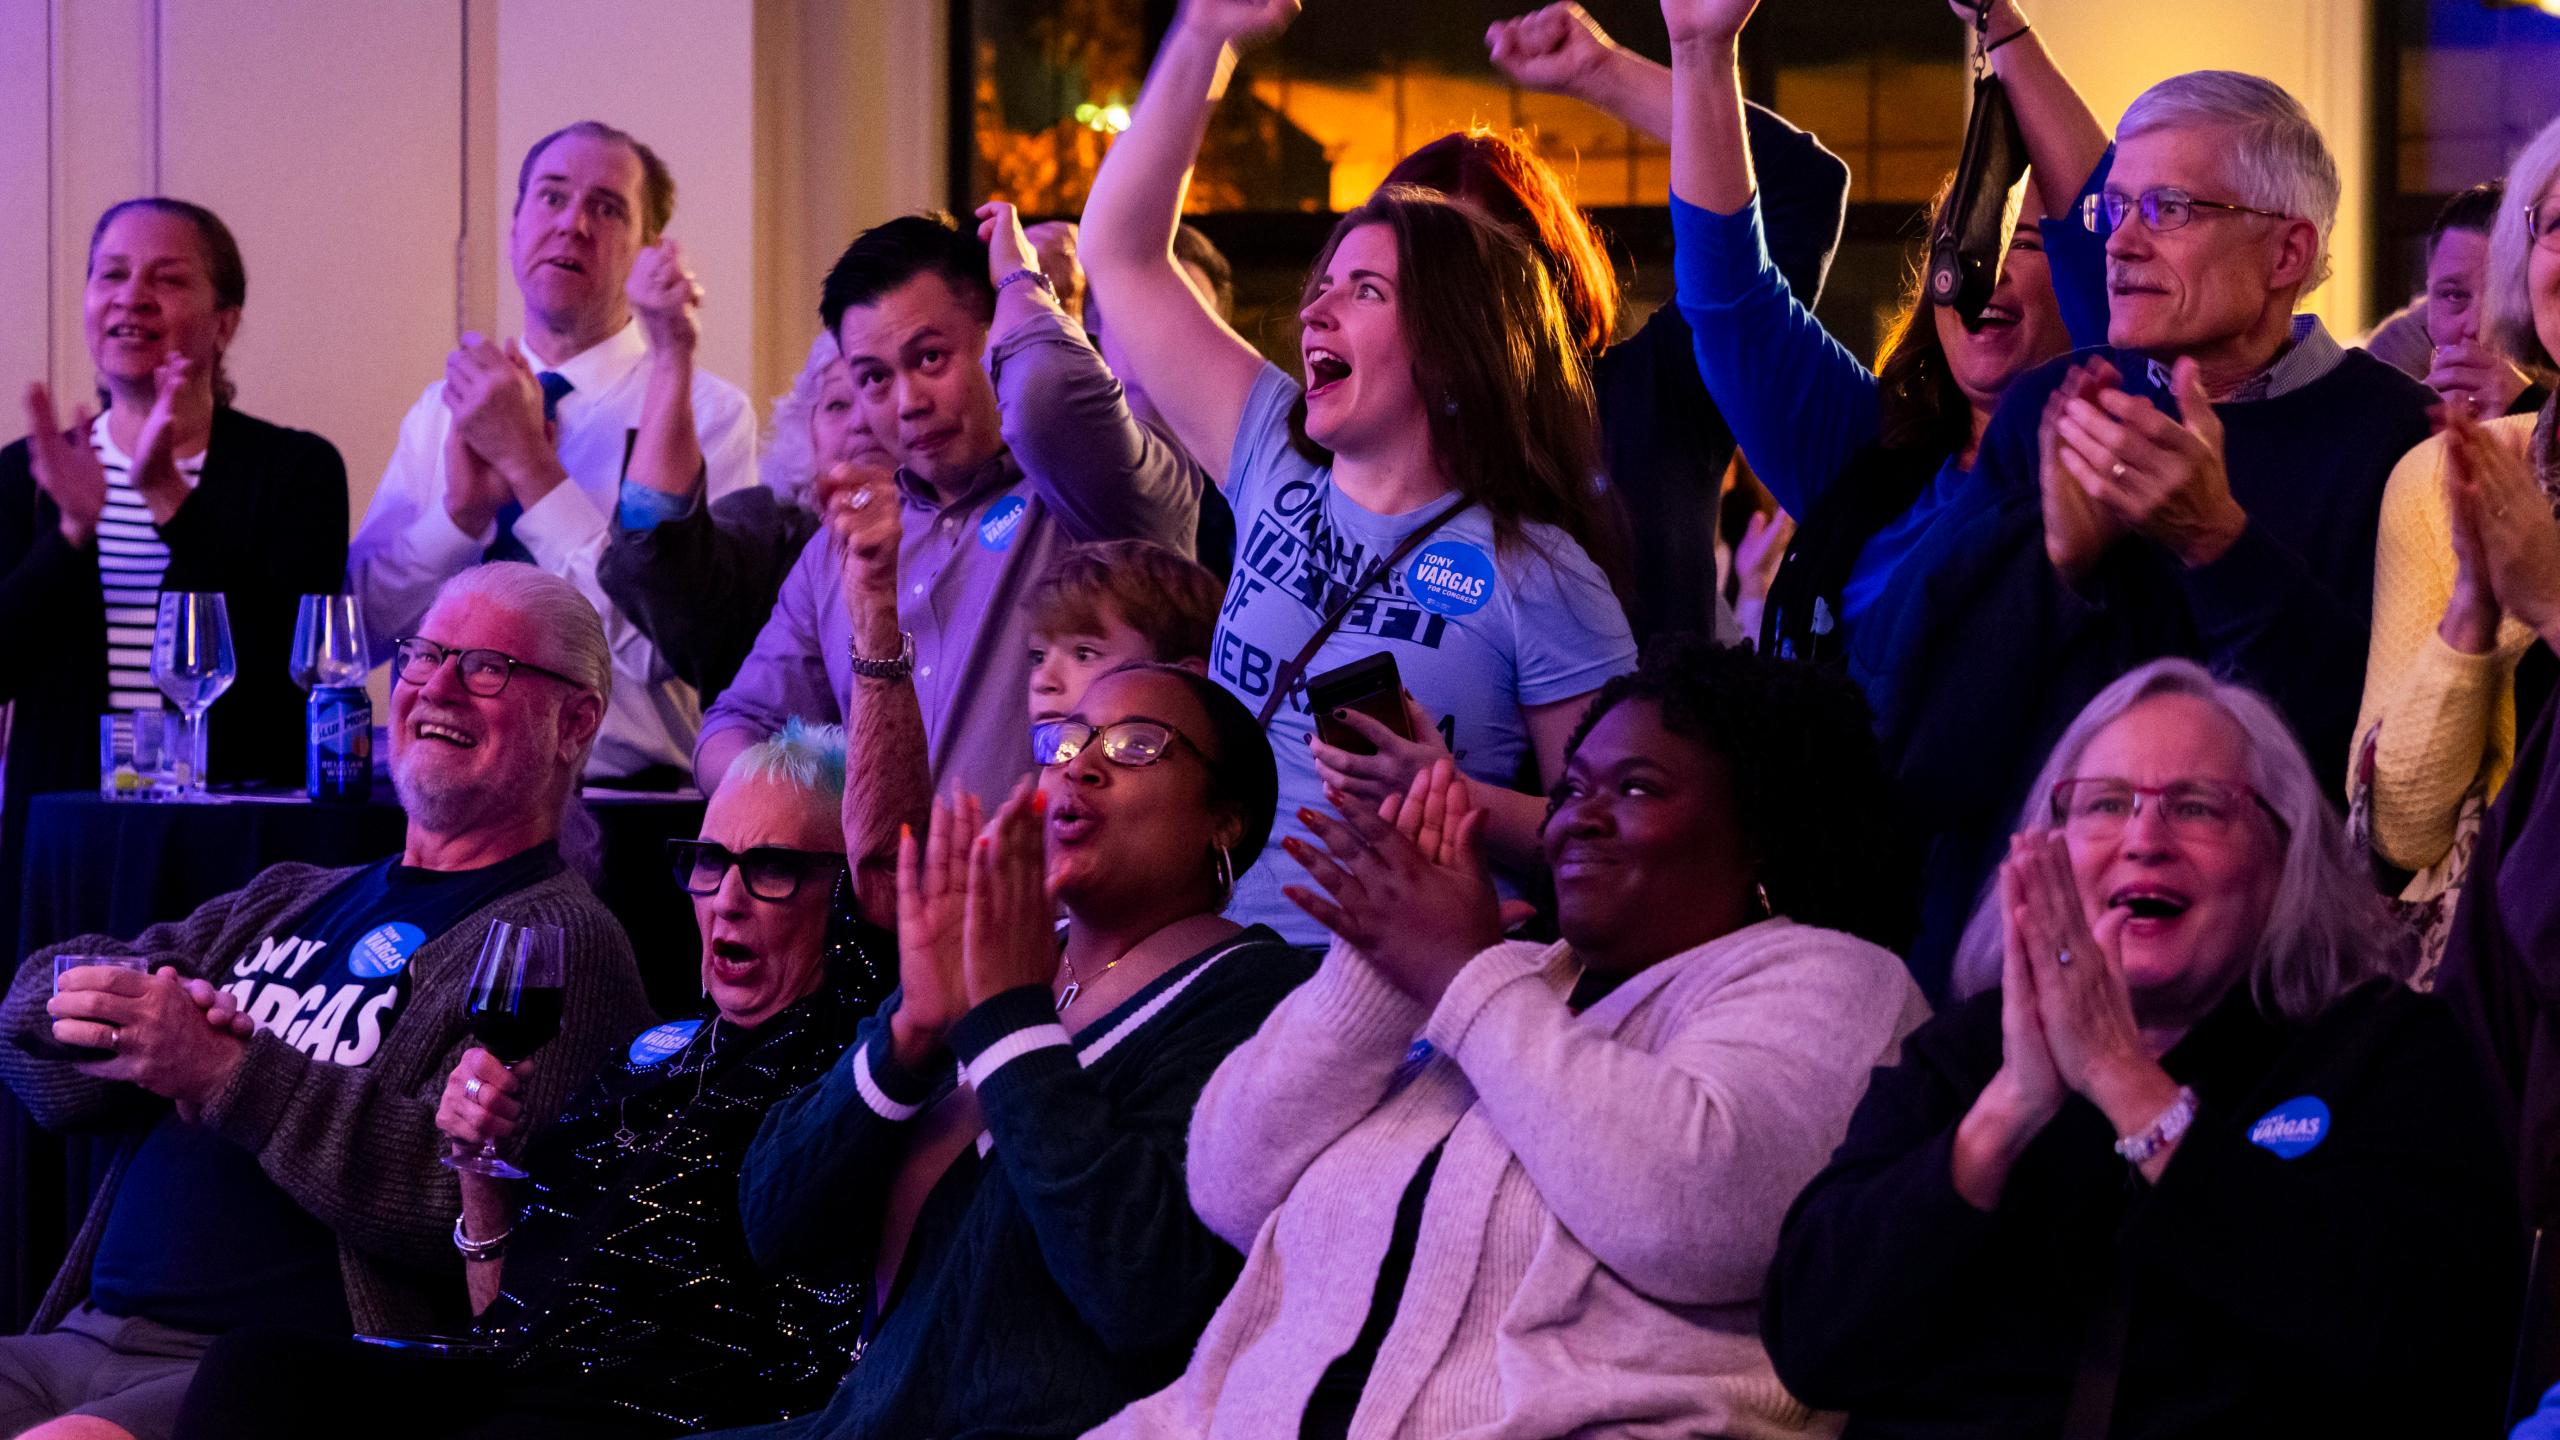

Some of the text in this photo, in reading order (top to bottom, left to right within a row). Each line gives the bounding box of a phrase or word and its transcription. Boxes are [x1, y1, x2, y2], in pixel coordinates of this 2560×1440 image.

[984, 503, 1023, 543] VARGAS
[1244, 511, 1311, 601] THE
[1424, 553, 1454, 568] TONY
[1222, 568, 1266, 622] OF
[1416, 564, 1485, 597] VARGAS
[1427, 584, 1440, 593] FOR
[1441, 589, 1478, 605] CONGRESS
[364, 931, 407, 970] VARGAS
[2252, 1117, 2320, 1142] VARGAS
